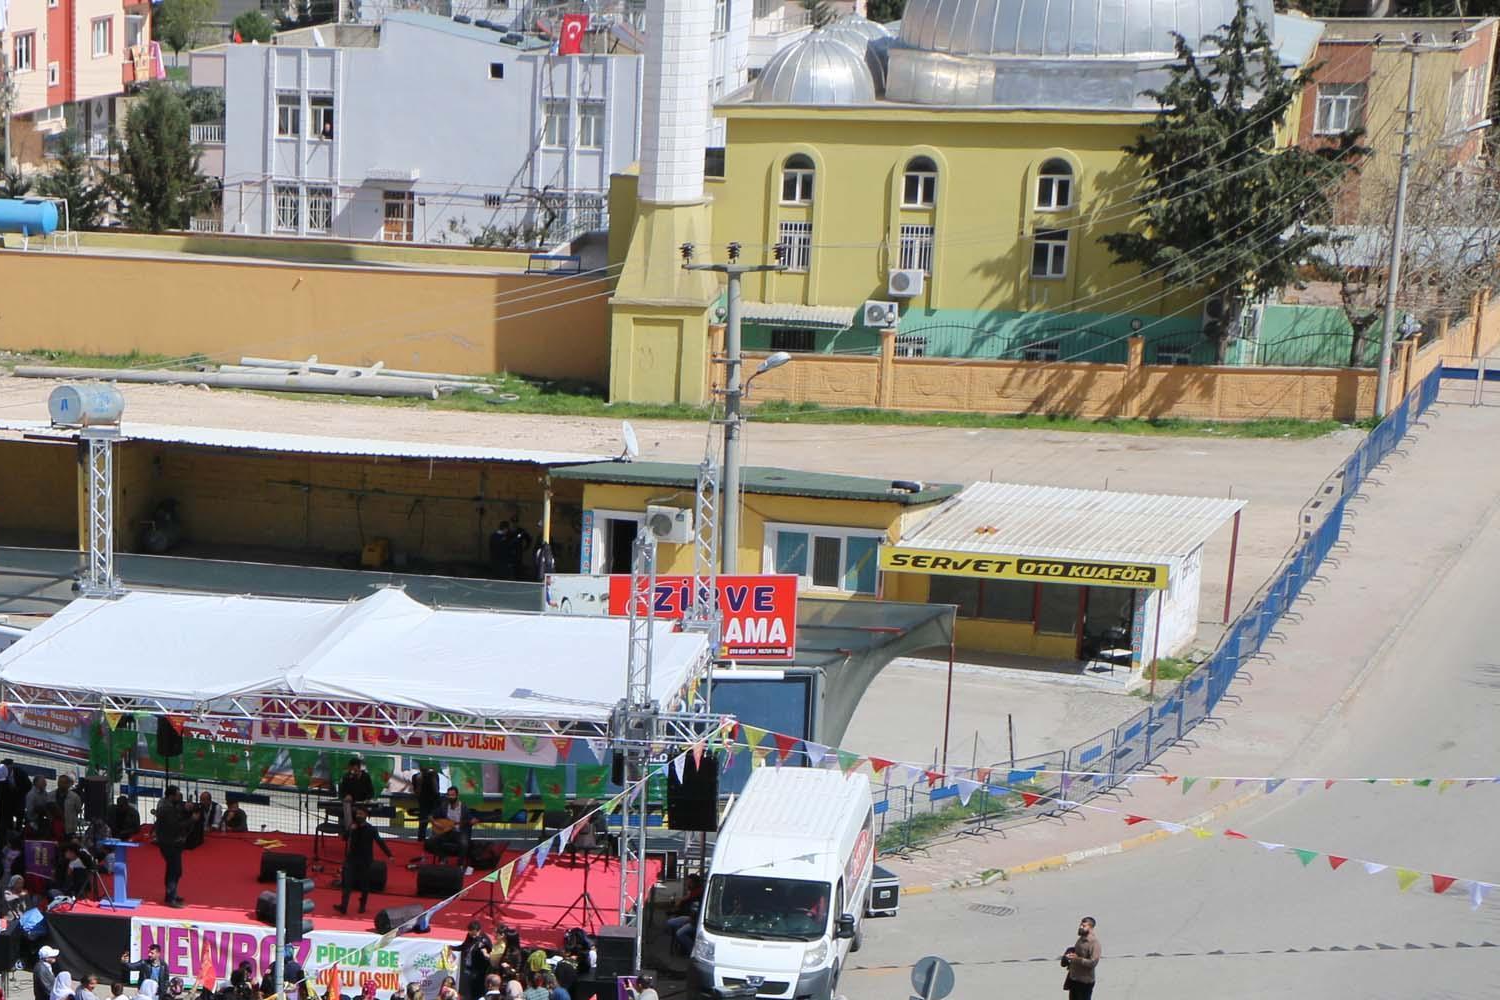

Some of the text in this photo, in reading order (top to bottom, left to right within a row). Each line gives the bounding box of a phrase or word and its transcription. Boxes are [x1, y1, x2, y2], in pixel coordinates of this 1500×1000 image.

[890, 554, 1151, 581] SERVET OTO KUAFÖR
[718, 617, 787, 643] AMA
[377, 949, 400, 969] BE
